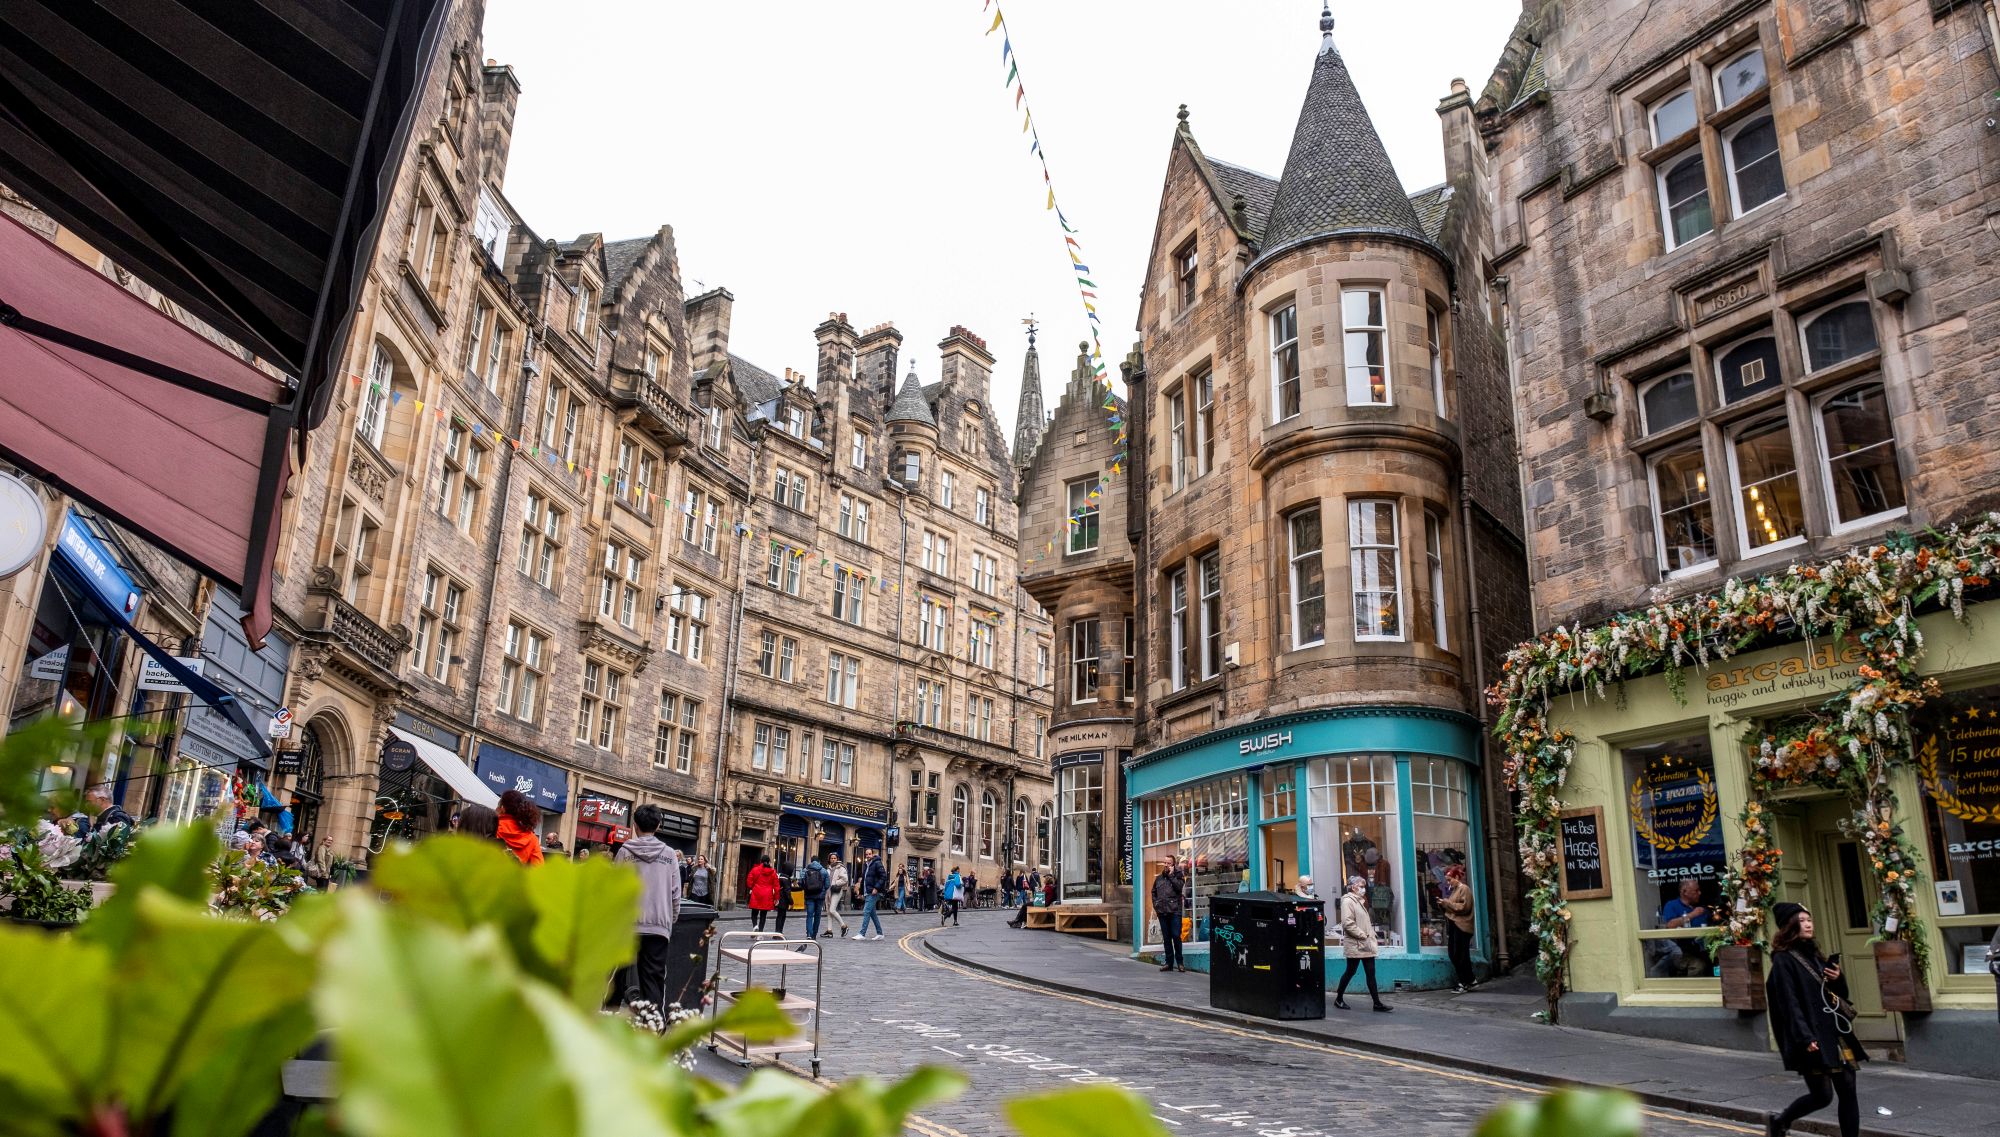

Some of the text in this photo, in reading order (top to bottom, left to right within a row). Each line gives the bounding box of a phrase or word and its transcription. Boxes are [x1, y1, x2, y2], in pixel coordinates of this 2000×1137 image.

[1712, 285, 1748, 311] 1860
[1706, 643, 1868, 692] arcade
[1707, 668, 1859, 707] haggis and whisky hou
[412, 719, 436, 738] SCRAN
[1058, 731, 1108, 744] THE MILKMAN
[1240, 730, 1292, 754] SWISH
[190, 741, 225, 764] SCOTTISH GIFTS
[1947, 746, 1968, 763] 15
[488, 771, 506, 784] Health
[1648, 771, 1689, 782] Celebrating
[1962, 769, 1999, 779] serving
[514, 775, 533, 794] Boots
[1956, 784, 1976, 795] best
[541, 787, 558, 801] Beauty
[1649, 786, 1663, 800] 15
[609, 801, 628, 816] Hut
[793, 794, 878, 818] The SCOTSMAN'S LOUNGE
[1659, 807, 1684, 816] serving
[1686, 802, 1697, 812] the
[1562, 822, 1578, 834] THE
[1654, 817, 1694, 829] best haggis
[1564, 837, 1599, 856] HAGGIS
[1977, 850, 1992, 858] and
[1577, 858, 1600, 870] TOWN
[1648, 862, 1715, 878] arcade
